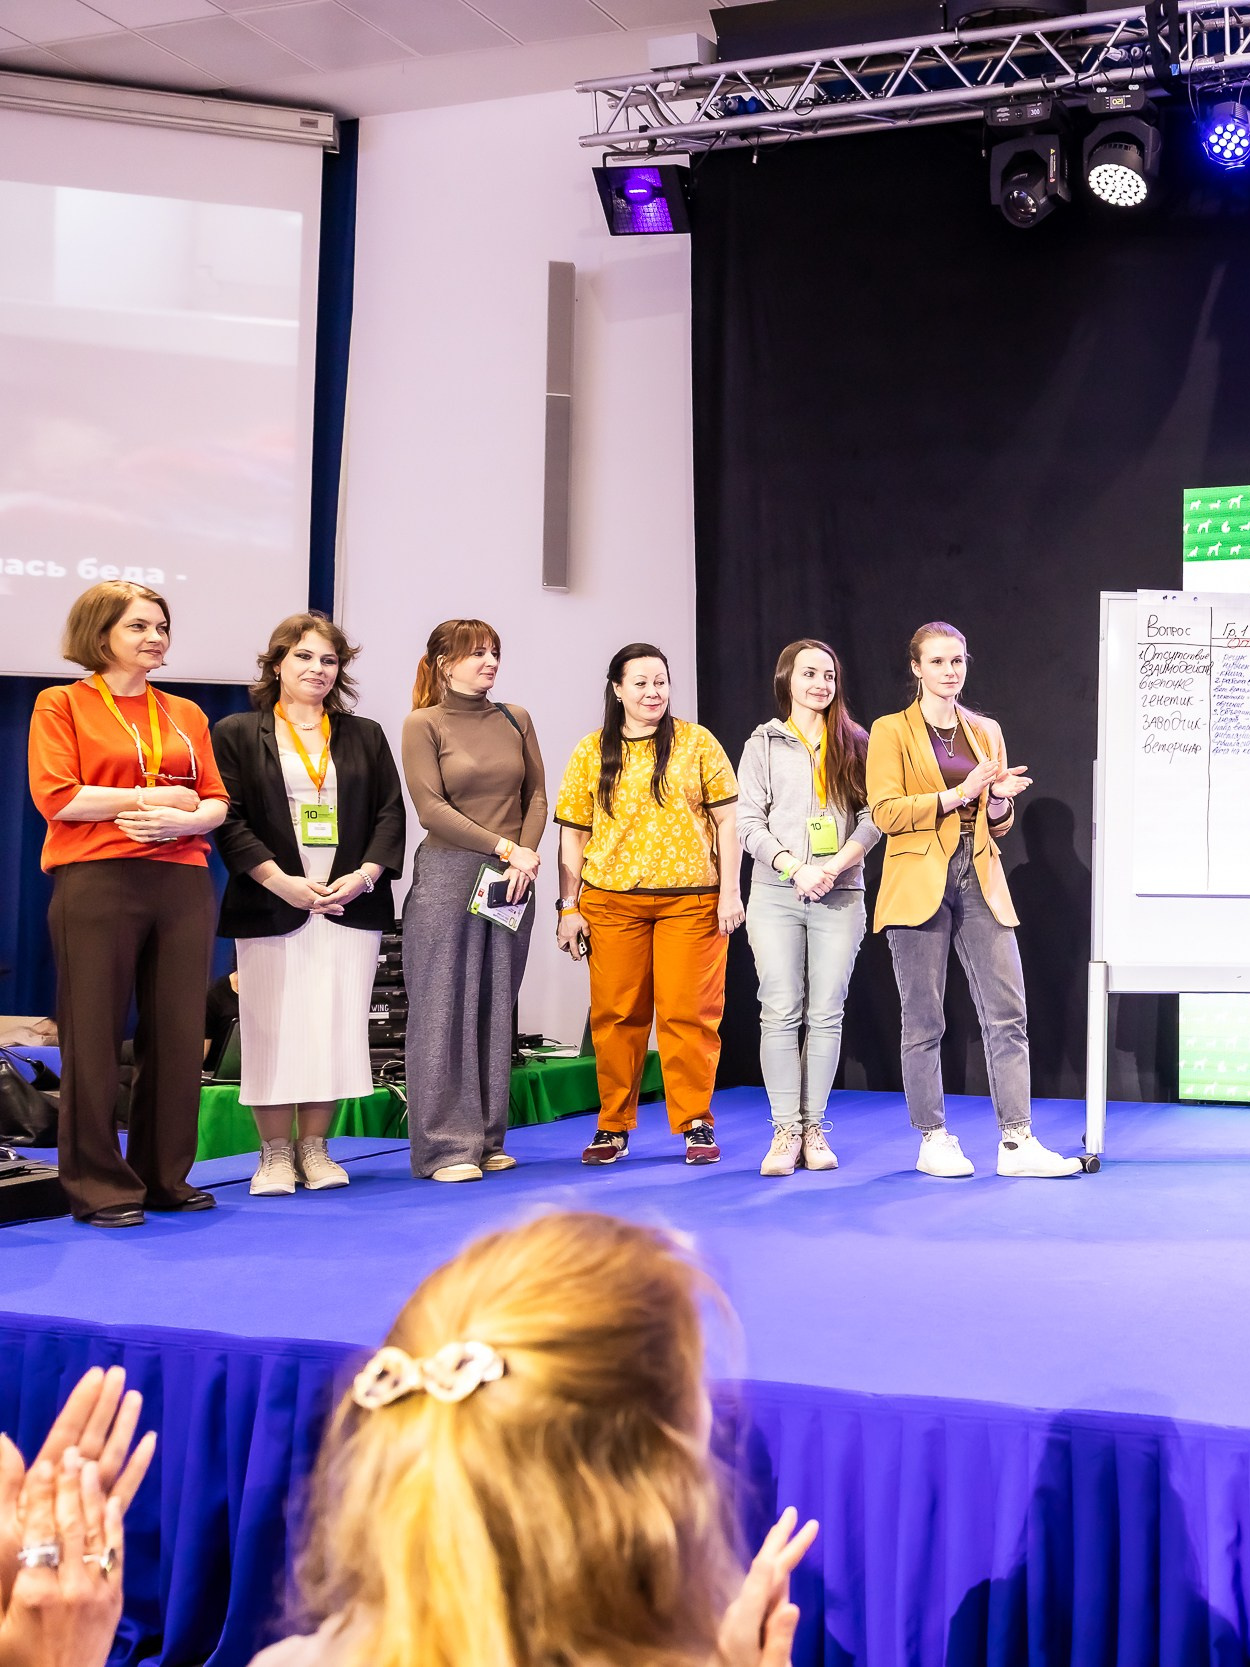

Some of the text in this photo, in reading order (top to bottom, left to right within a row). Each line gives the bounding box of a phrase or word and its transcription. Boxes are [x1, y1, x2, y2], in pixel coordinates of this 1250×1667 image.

[77, 557, 165, 585] беда
[1147, 614, 1191, 637] Вопрос
[304, 810, 318, 819] 10
[810, 822, 822, 831] 10
[371, 1004, 390, 1013] WING
